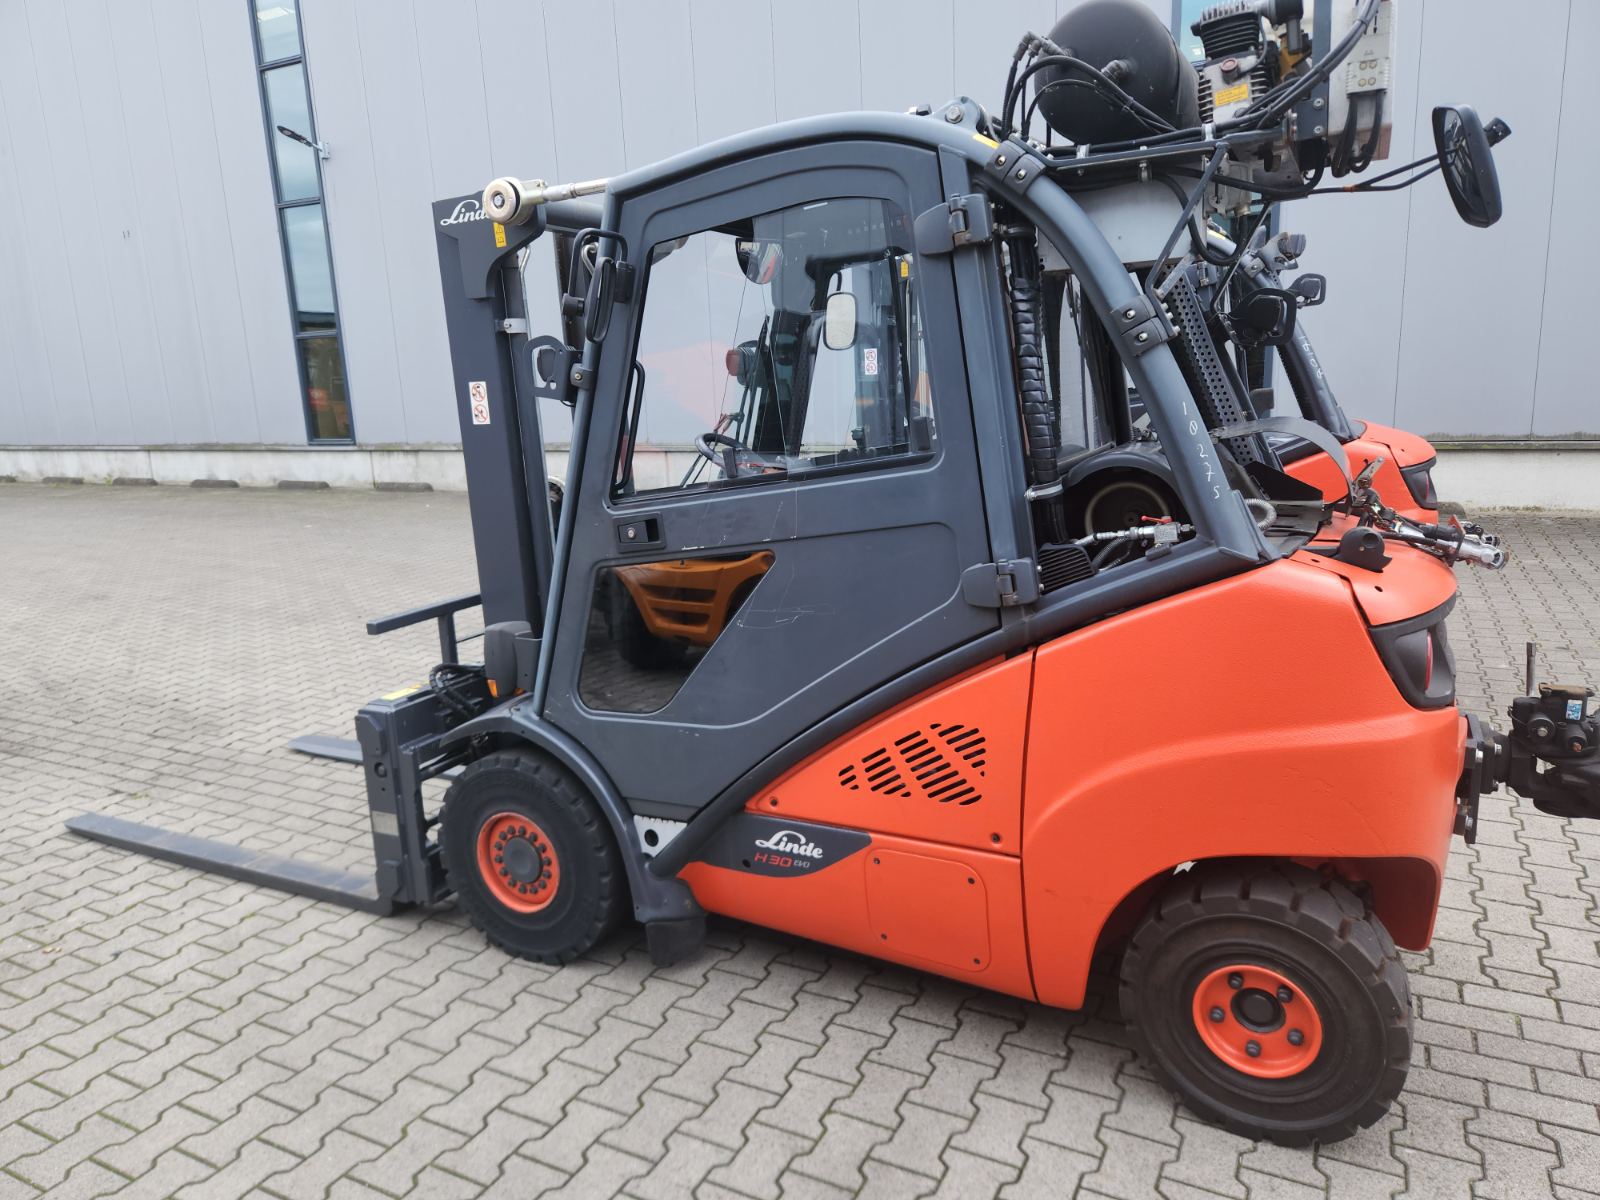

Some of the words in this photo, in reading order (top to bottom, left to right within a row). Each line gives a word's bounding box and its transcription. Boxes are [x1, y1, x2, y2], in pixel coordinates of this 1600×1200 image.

[440, 199, 490, 226] Lind
[1182, 401, 1220, 499] 10275
[755, 830, 823, 859] Linde
[754, 852, 768, 863] H
[768, 854, 793, 868] 30
